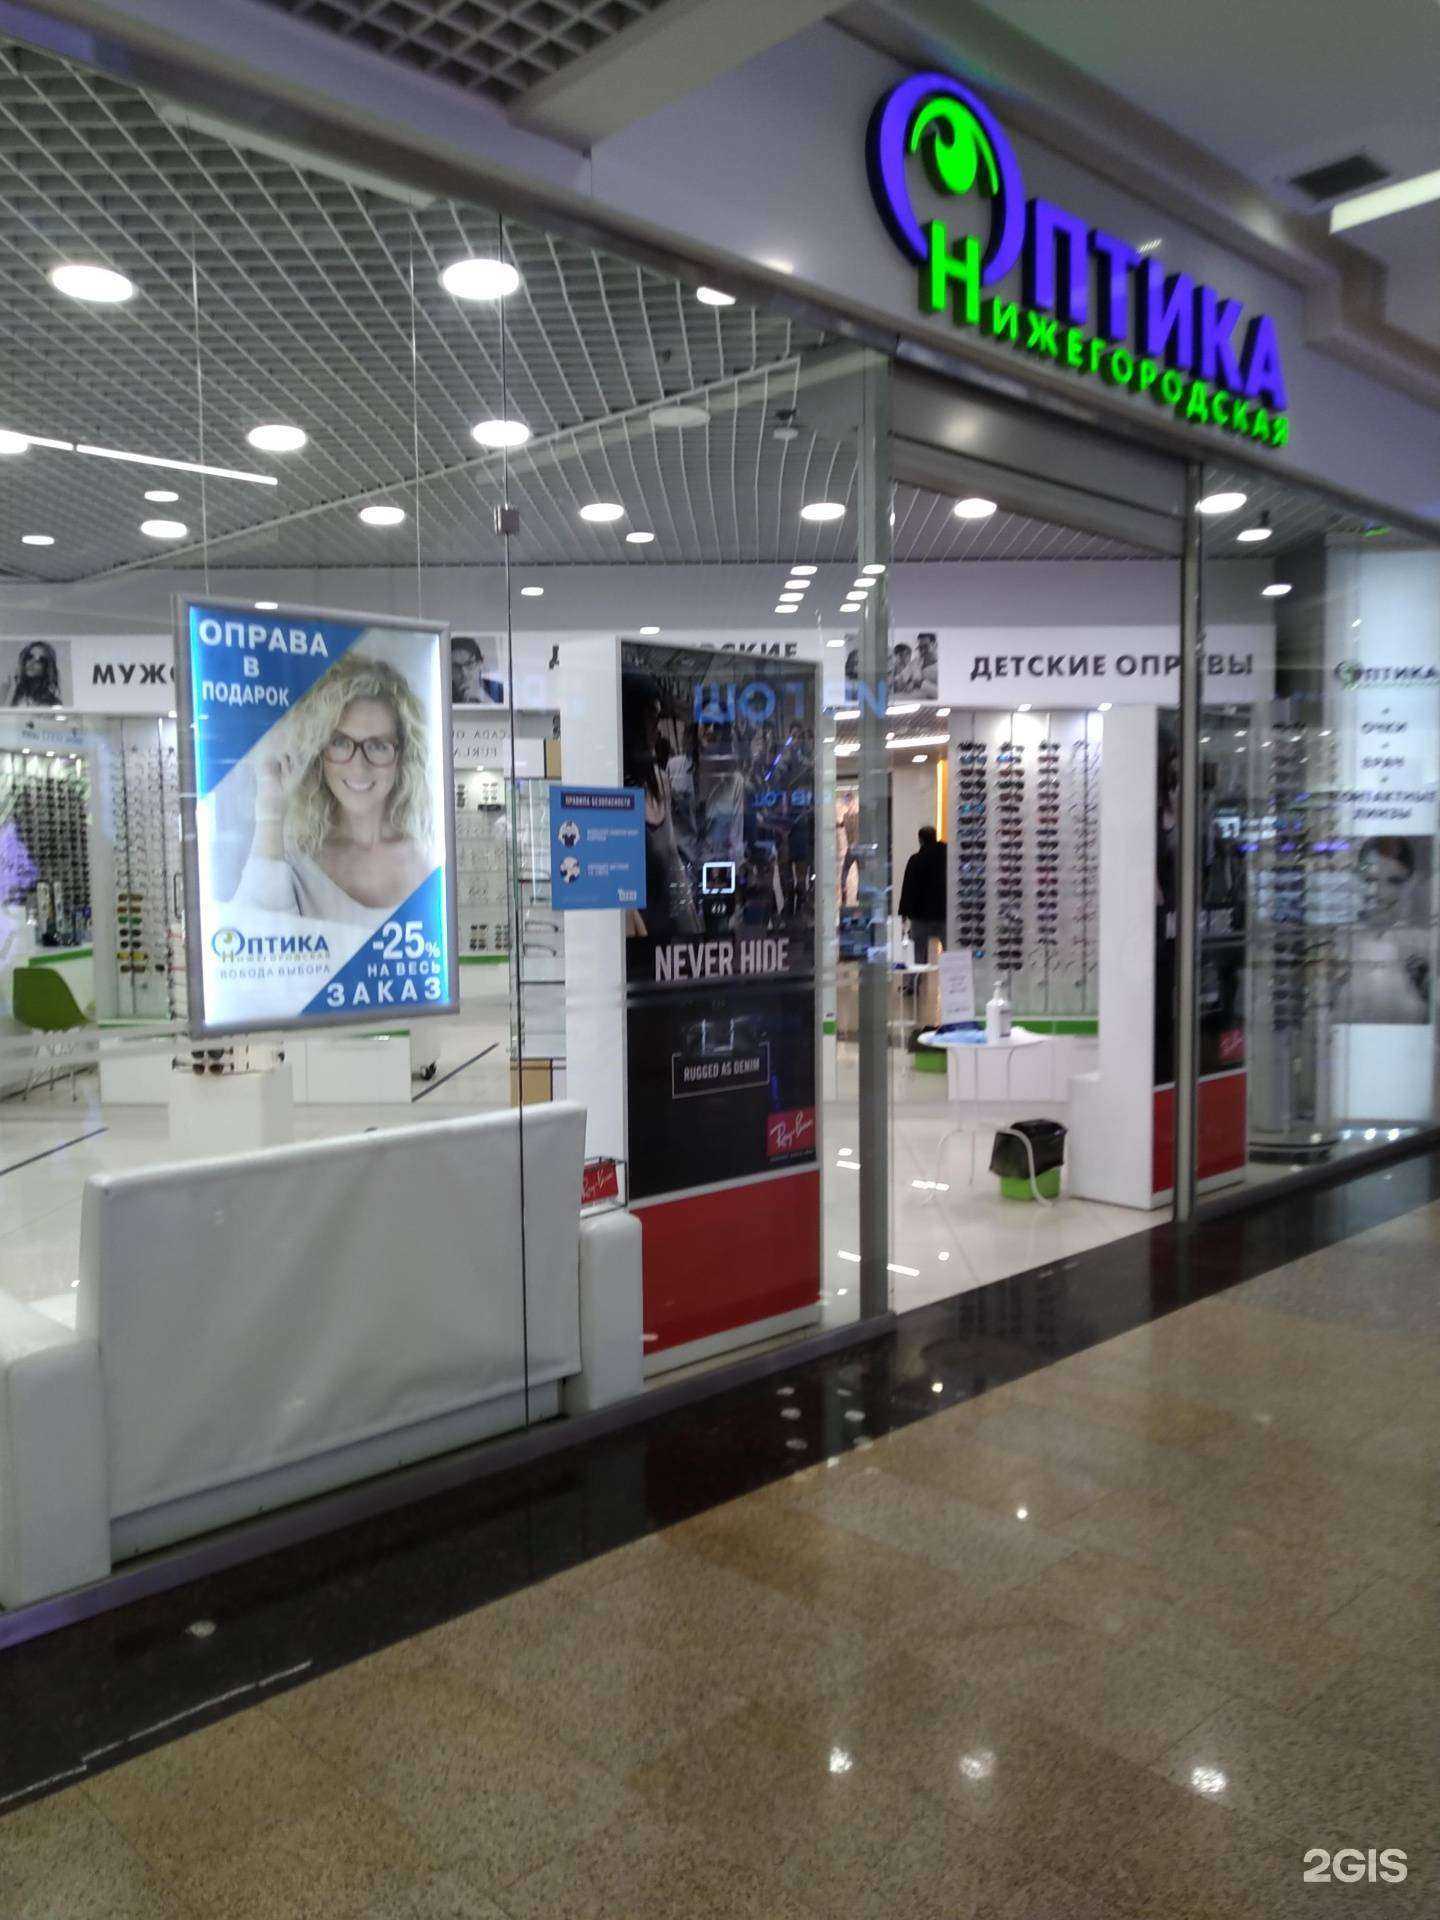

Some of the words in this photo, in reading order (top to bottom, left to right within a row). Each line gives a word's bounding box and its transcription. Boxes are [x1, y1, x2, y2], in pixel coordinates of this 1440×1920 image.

[868, 72, 1288, 411] ОПТИКА
[923, 219, 1289, 447] НИЖЕГОРОДСКАЯ
[199, 619, 328, 657] ОПРАВА
[92, 663, 174, 685] МУЖ
[243, 655, 260, 678] В
[970, 654, 1106, 681] ДЕТСКИЕ
[1115, 654, 1253, 677] ОПРВЫ
[202, 680, 290, 707] ПОДАРОК
[211, 927, 329, 957] ОПТИКА
[372, 921, 441, 960] -25%
[367, 963, 390, 977] НА
[396, 961, 441, 976] ВЕСЬ
[655, 939, 733, 982] NEVER
[740, 938, 791, 974] HIDE
[326, 976, 442, 1007] ЗАКАЗ
[683, 1063, 719, 1082] RUGGED
[721, 1061, 732, 1077] AS
[734, 1057, 761, 1074] DENIM
